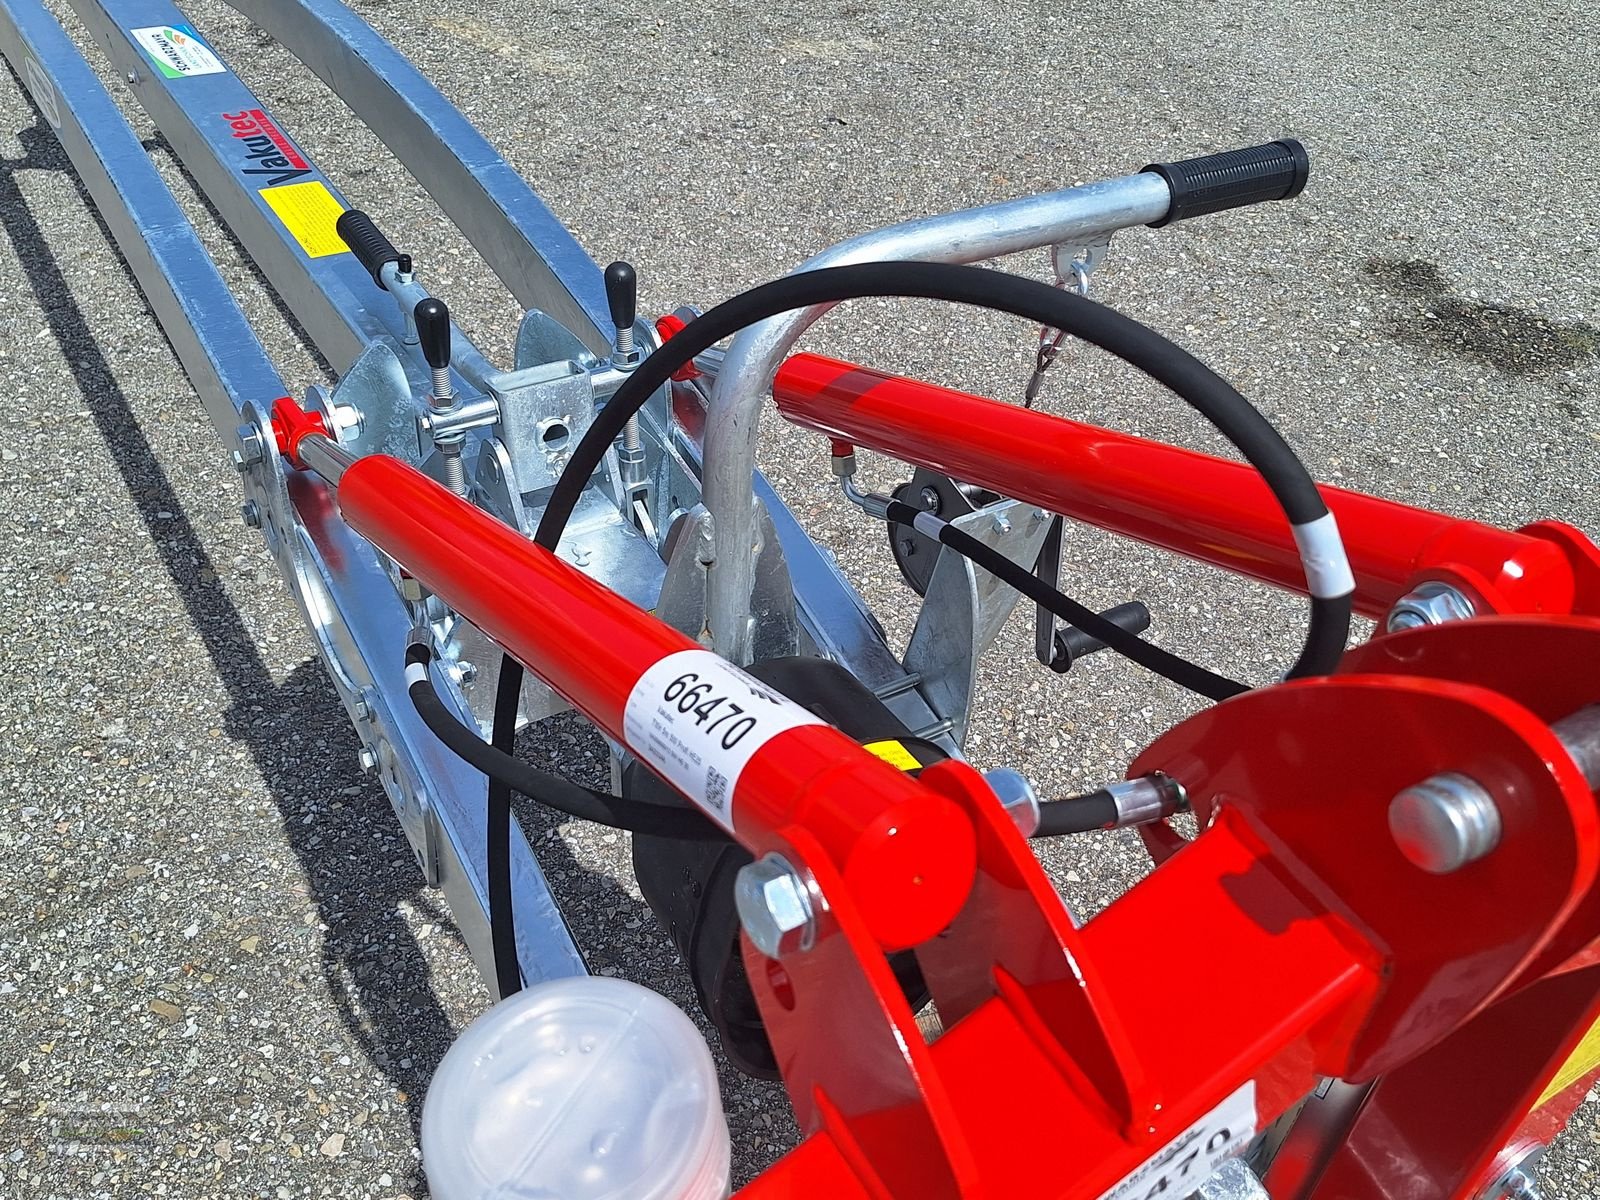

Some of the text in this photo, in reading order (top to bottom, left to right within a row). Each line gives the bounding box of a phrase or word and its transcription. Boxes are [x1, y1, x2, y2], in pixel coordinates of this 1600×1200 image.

[151, 33, 191, 72] SCHWARZMAYR
[222, 111, 312, 185] Vakutec
[664, 673, 757, 750] 66470
[1132, 1127, 1231, 1200] 470
